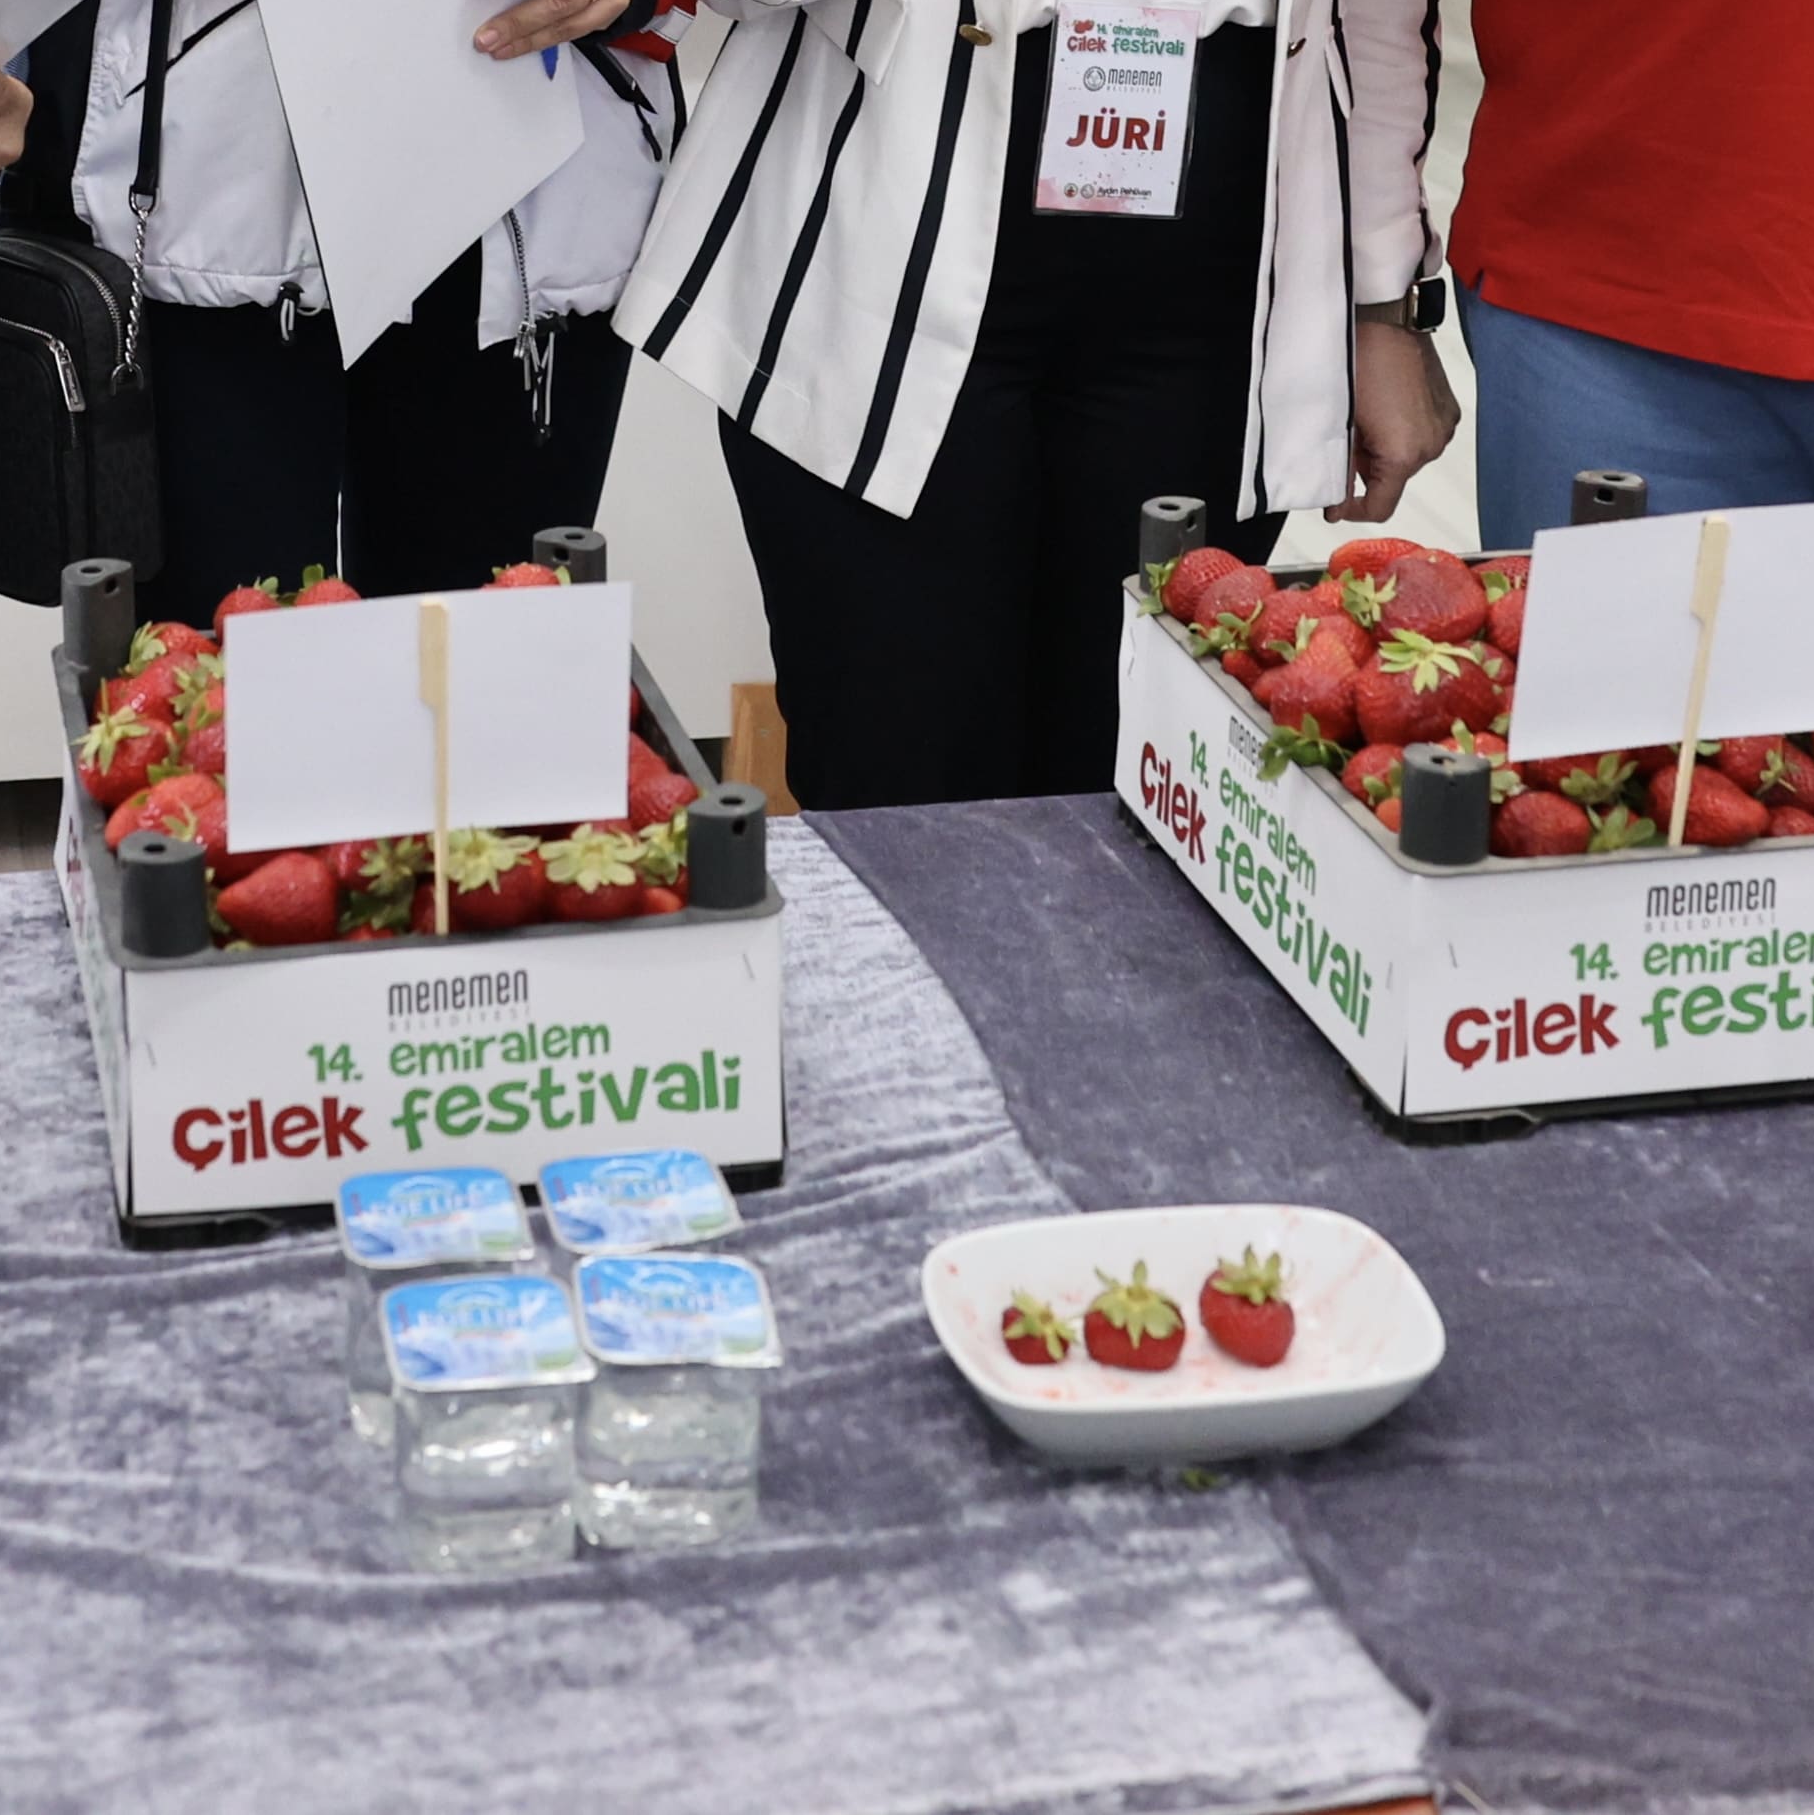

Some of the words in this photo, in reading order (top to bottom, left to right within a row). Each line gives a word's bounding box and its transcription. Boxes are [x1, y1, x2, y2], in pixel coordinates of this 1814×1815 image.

[1066, 36, 1108, 54] Çilek
[1111, 37, 1186, 57] festivali
[1107, 67, 1163, 87] menemen
[1065, 107, 1168, 152] JÜRİ
[1229, 715, 1267, 769] mene
[1189, 729, 1209, 789] 14.
[1219, 767, 1317, 897] emiralem
[1140, 741, 1207, 866] Çilek
[1215, 823, 1373, 1038] festivali
[1646, 877, 1776, 918] menemen
[1569, 942, 1620, 981] 14.
[388, 968, 529, 1017] menemen
[307, 1043, 363, 1083] 14.
[389, 1022, 611, 1077] emiralem
[1443, 993, 1621, 1072] Çilek
[171, 1096, 369, 1172] Çilek
[391, 1049, 743, 1152] festivali
